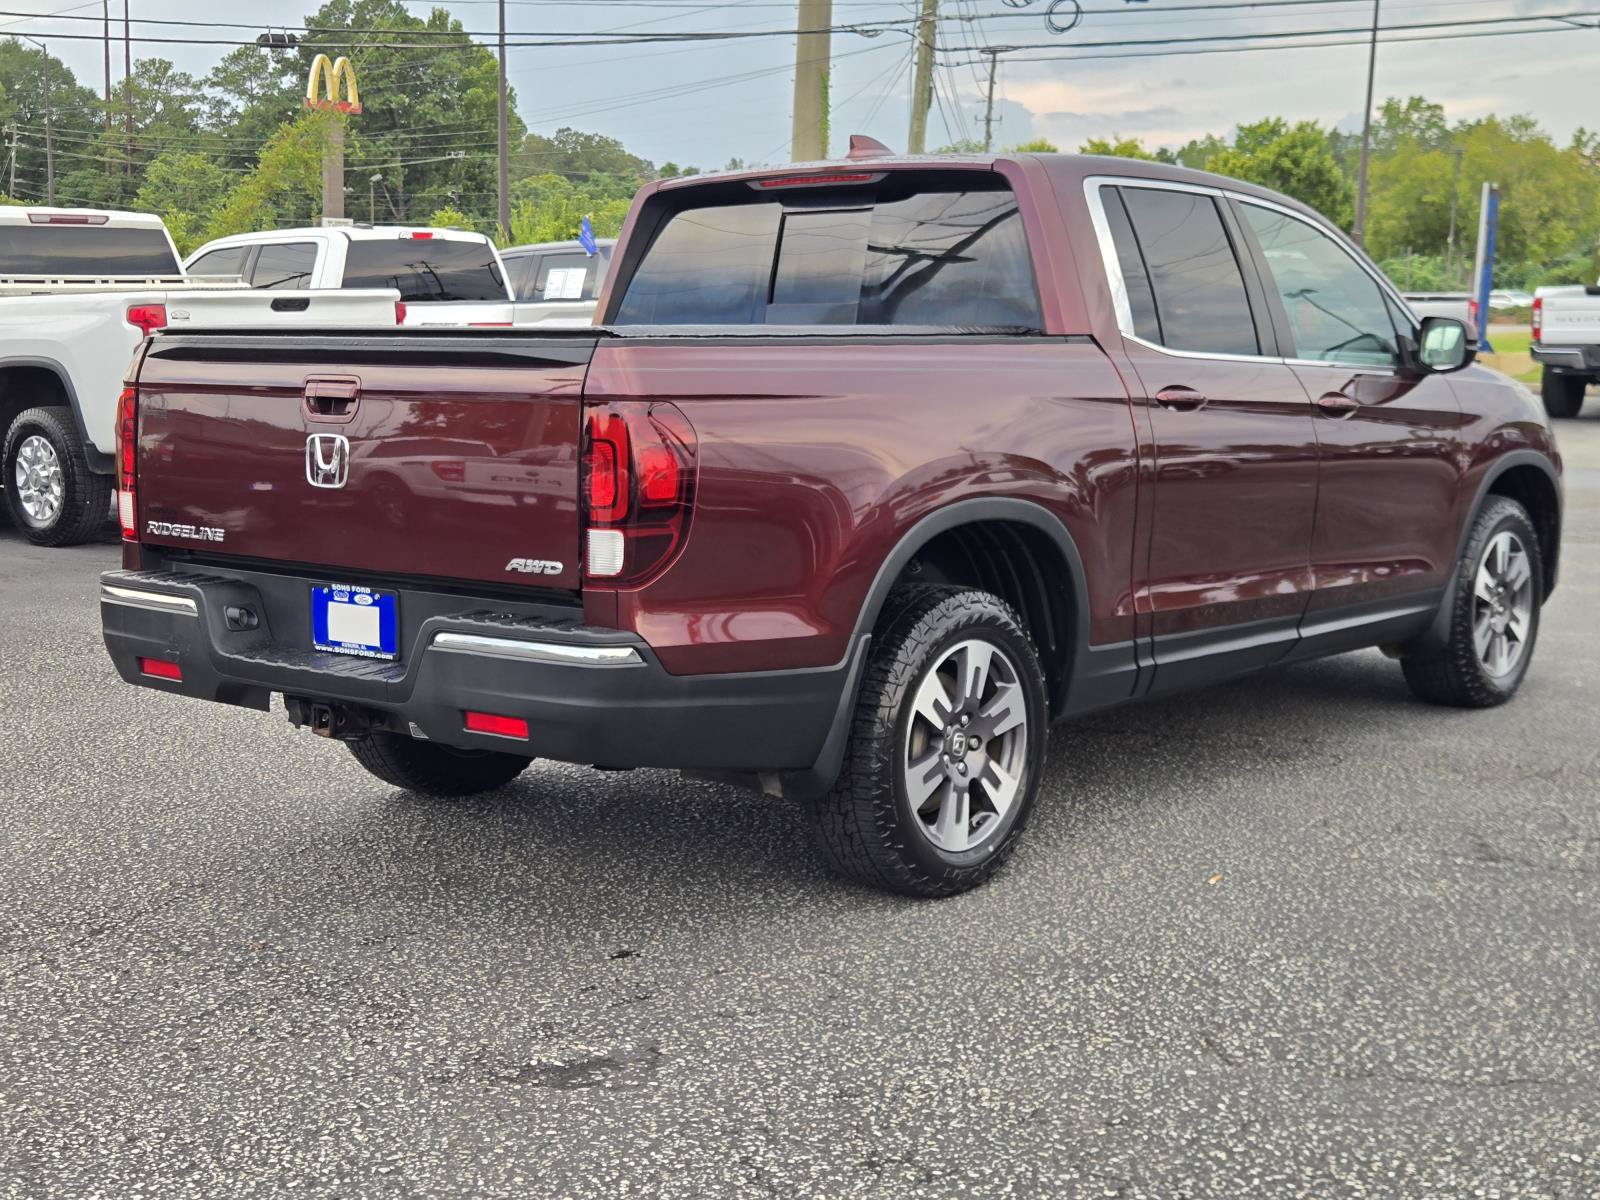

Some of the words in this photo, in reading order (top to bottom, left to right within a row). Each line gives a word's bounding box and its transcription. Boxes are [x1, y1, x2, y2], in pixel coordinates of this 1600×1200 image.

[146, 520, 225, 542] RIDGELINE
[505, 557, 564, 576] AWD
[332, 583, 351, 592] SONS
[352, 585, 371, 594] FORD
